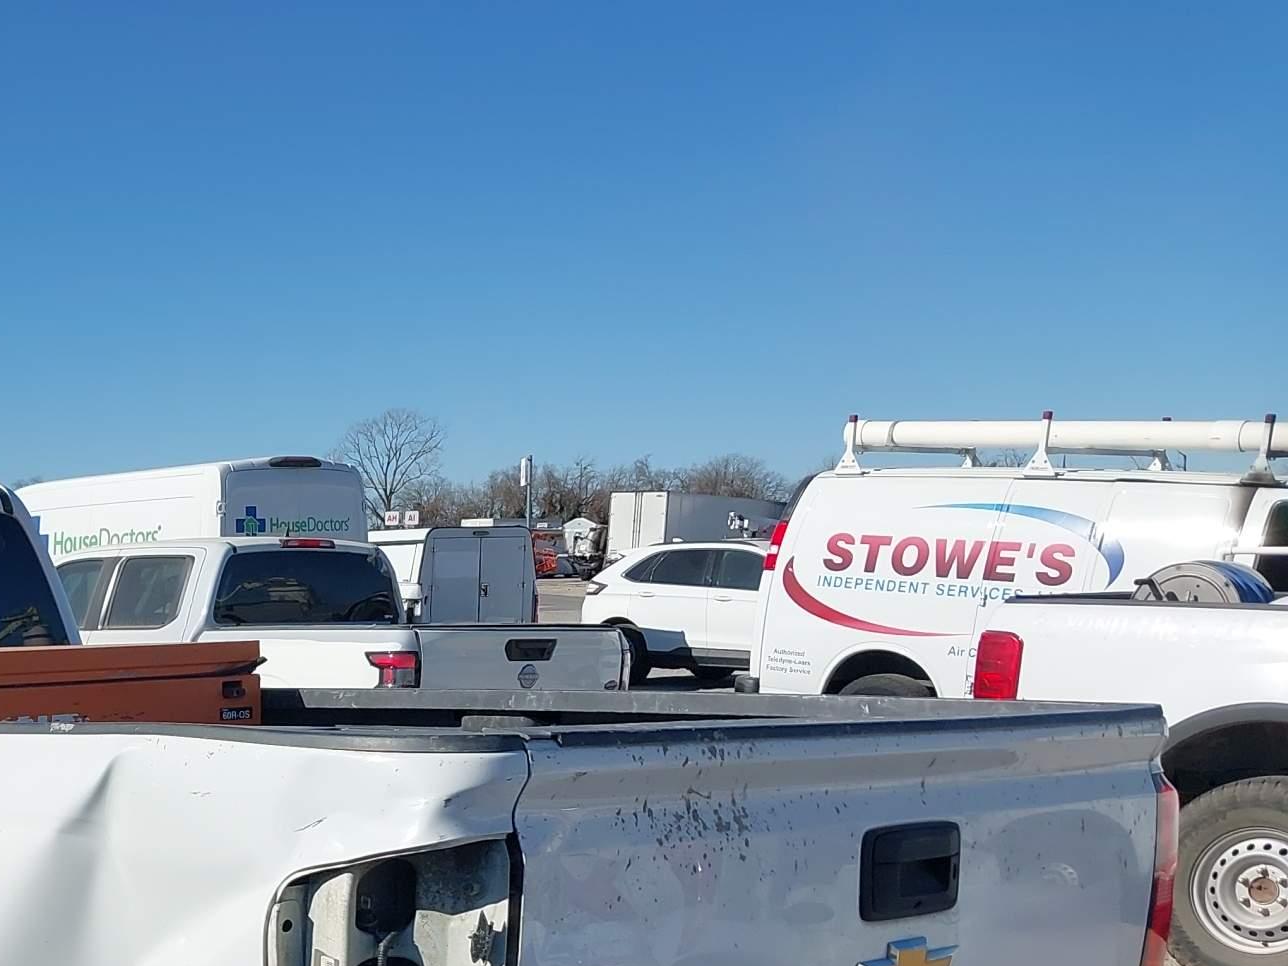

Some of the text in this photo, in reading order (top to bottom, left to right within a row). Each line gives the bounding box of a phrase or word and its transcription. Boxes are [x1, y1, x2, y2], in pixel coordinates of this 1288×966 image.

[822, 532, 1077, 587] STOWE'S
[816, 575, 931, 596] INDEPENDENT
[947, 645, 966, 657] Air
